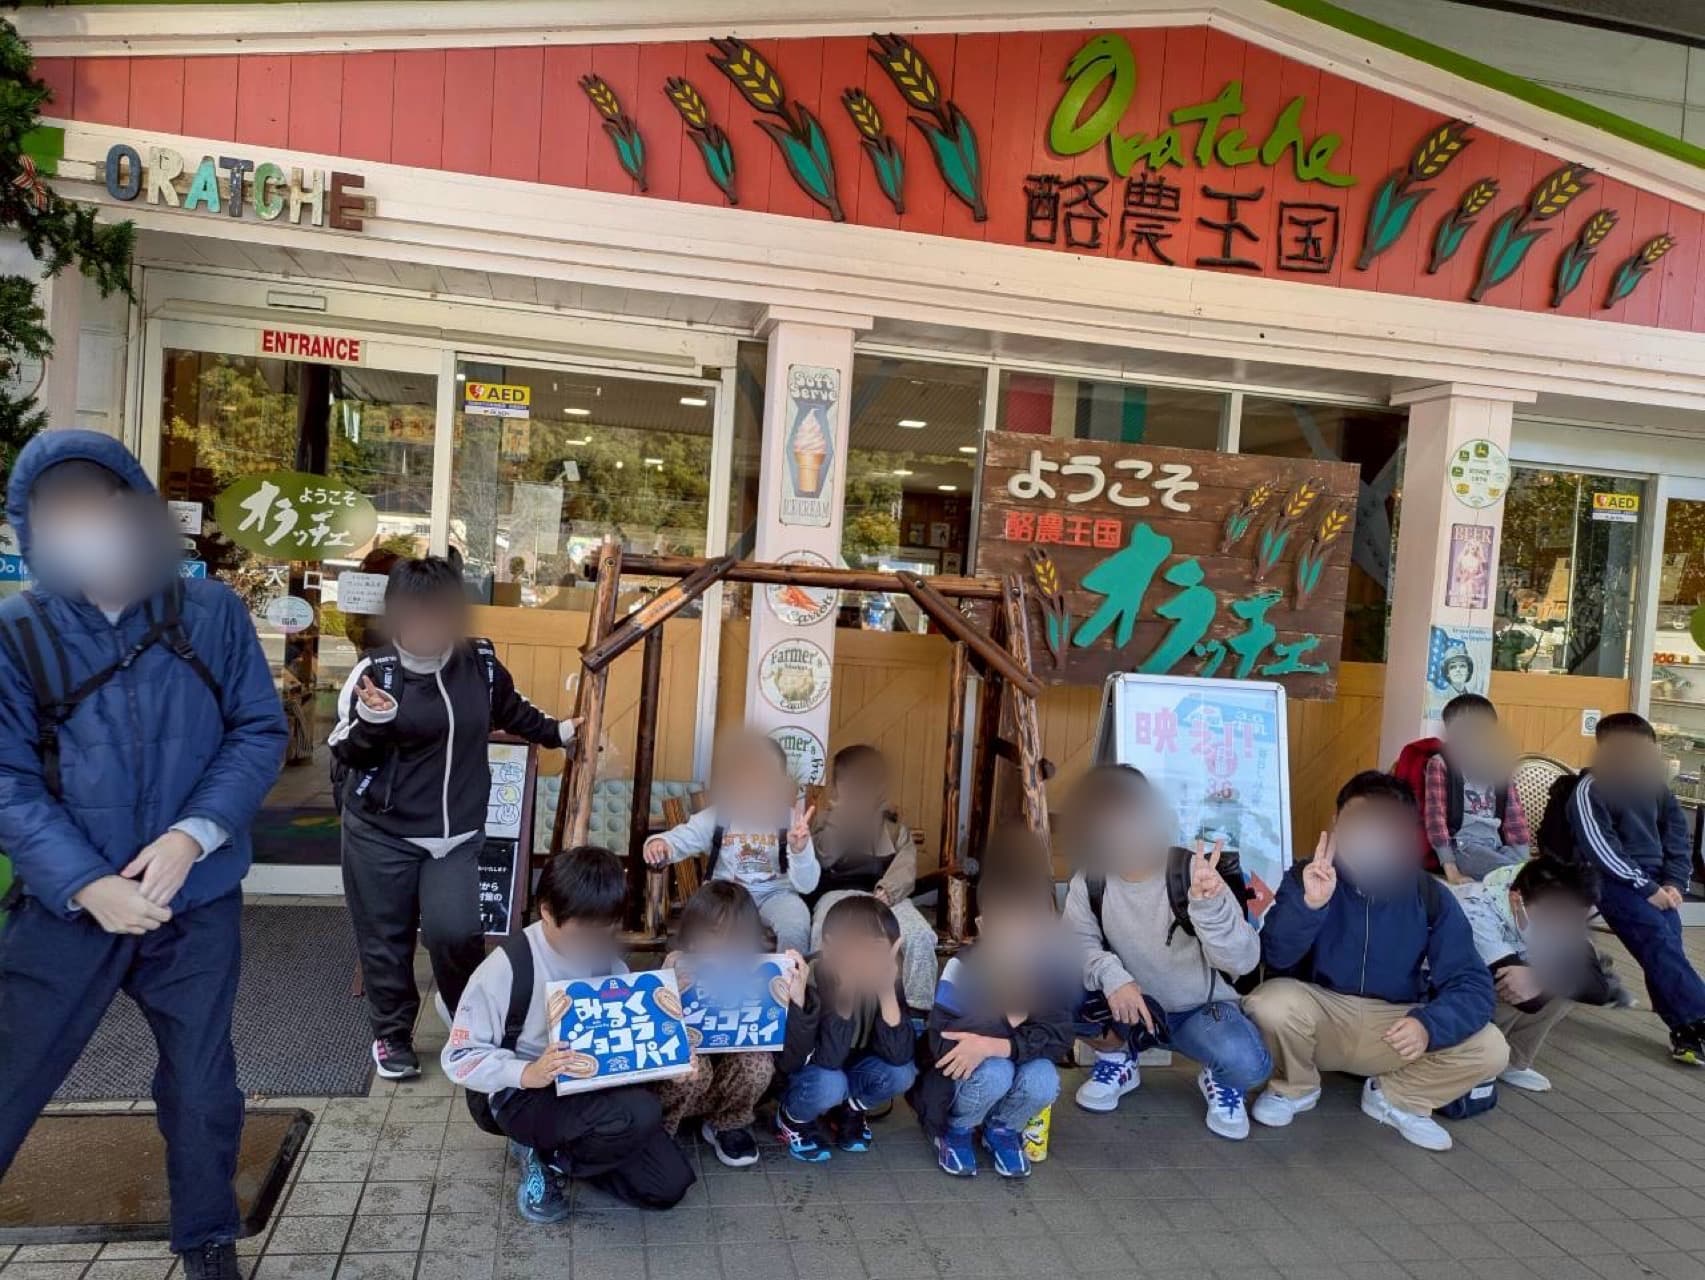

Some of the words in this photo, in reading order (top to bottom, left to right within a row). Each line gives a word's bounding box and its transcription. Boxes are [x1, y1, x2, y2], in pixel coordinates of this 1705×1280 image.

[105, 144, 365, 232] ORATCHE
[1024, 174, 1340, 273] 酪農王国
[263, 330, 360, 361] ENTRANCE
[487, 387, 525, 402] AED
[300, 488, 356, 507] ようこそ
[1008, 450, 1199, 512] ようこそ
[238, 481, 355, 548] オラッチェ
[1608, 496, 1635, 508] AED
[1005, 511, 1123, 549] 酪農王国
[1454, 527, 1493, 545] BEER
[264, 568, 323, 590] 入口
[1071, 522, 1330, 679] オラッチェ
[574, 991, 647, 1028] みるく
[683, 1000, 762, 1031] ショコラ
[568, 1015, 655, 1055] ショコラ
[735, 1020, 778, 1046] パイ
[635, 1035, 680, 1069] パイ
